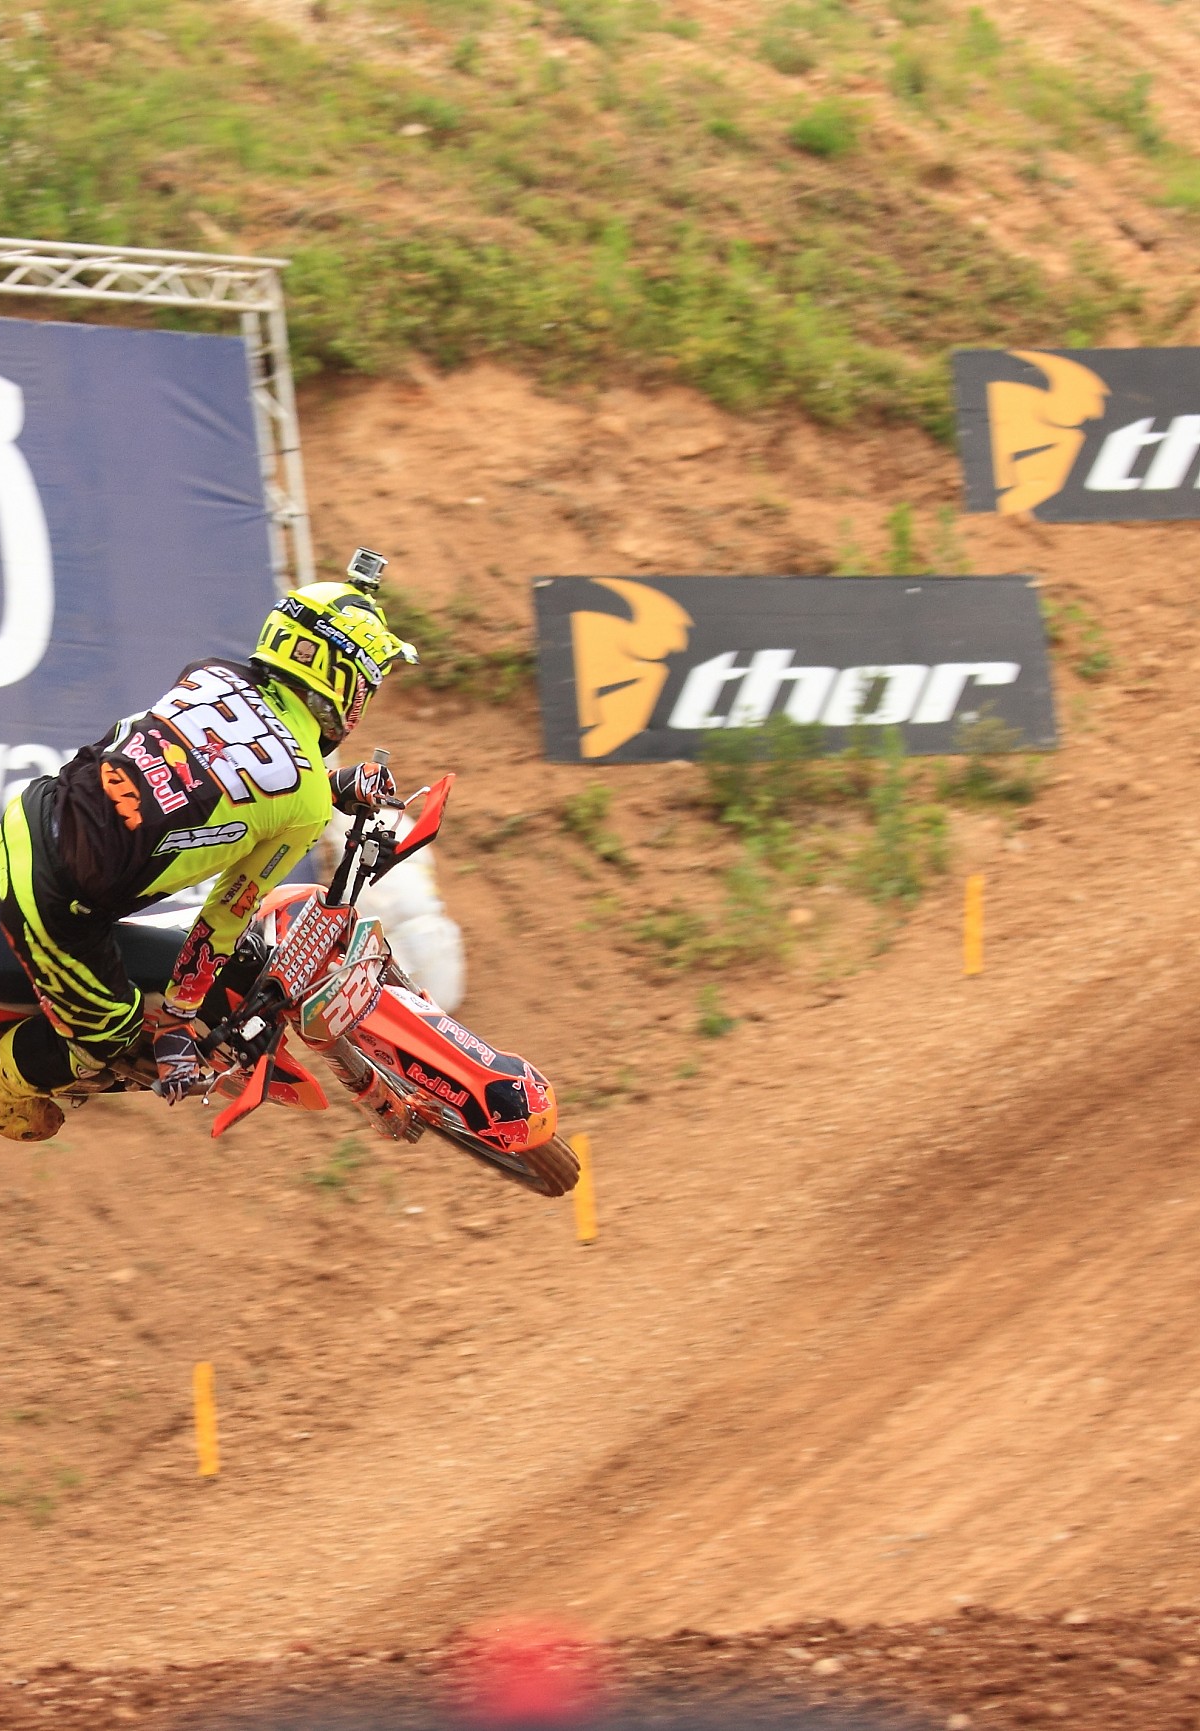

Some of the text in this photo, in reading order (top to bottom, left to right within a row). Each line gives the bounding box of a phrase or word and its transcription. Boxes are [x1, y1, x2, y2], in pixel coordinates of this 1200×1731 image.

[315, 619, 356, 650] GoPro
[205, 665, 312, 771] CAIROLI
[668, 649, 1021, 729] thor
[151, 668, 300, 806] 222
[101, 761, 143, 832] KTM
[275, 905, 323, 973] RENTHAL
[284, 915, 333, 983] RENTHAL
[288, 912, 348, 999] RENTHAL
[321, 933, 384, 1037] 222
